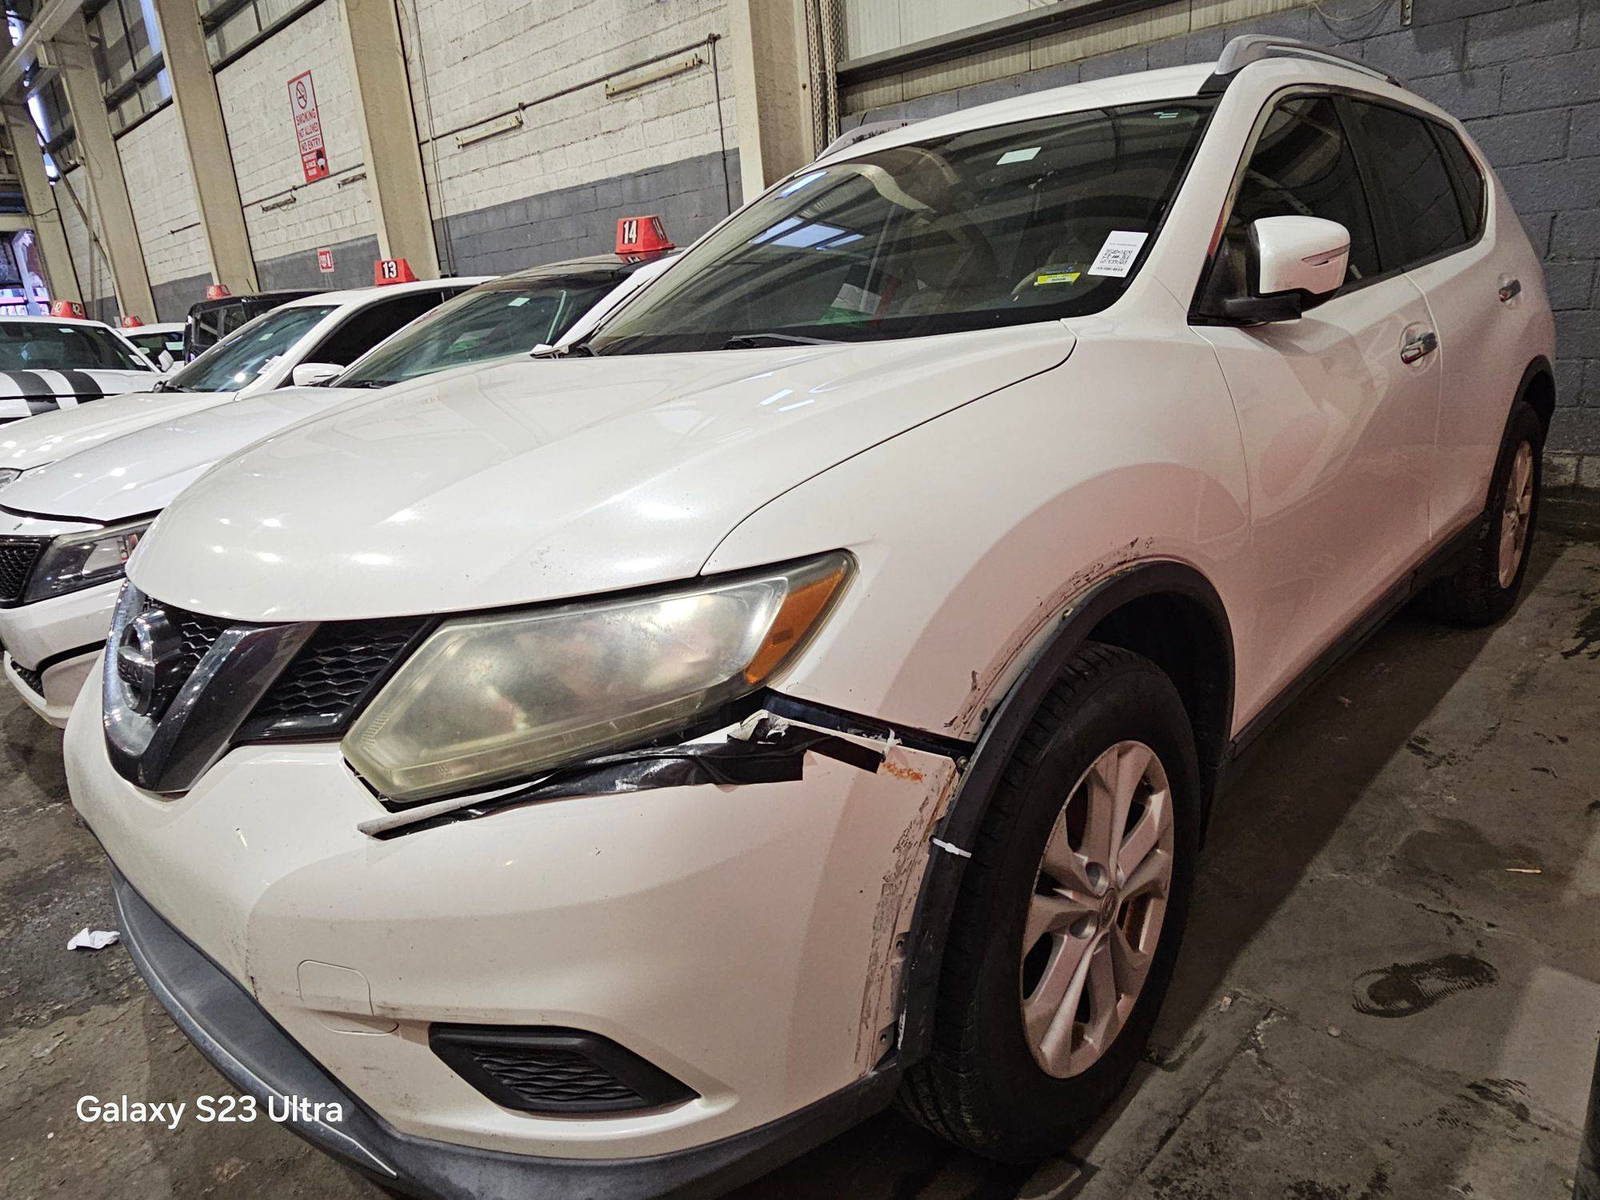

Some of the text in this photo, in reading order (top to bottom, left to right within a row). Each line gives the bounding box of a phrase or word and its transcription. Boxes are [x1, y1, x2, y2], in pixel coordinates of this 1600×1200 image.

[296, 108, 316, 126] SMOKING
[301, 138, 320, 152] NO ENTRY
[623, 219, 637, 244] 14
[382, 260, 397, 279] 13
